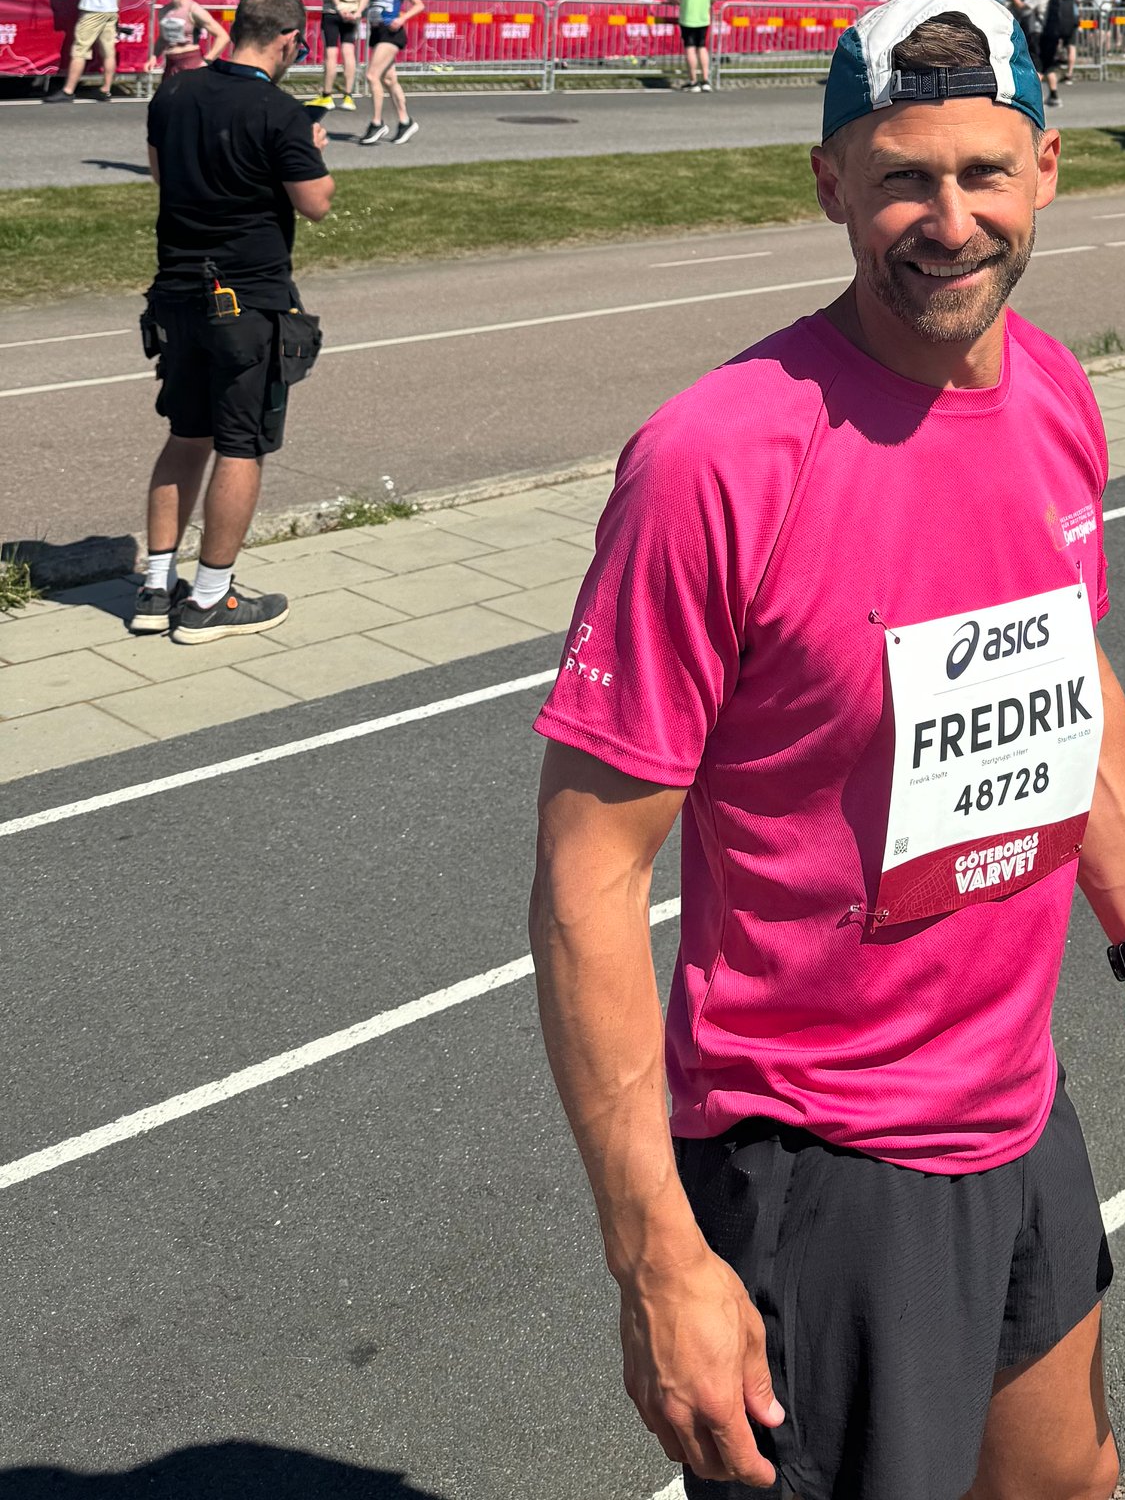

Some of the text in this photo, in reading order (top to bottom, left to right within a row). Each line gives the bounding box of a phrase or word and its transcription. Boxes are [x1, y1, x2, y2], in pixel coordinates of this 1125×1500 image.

[912, 676, 1093, 769] FREDRIK
[953, 762, 1049, 816] 48728
[955, 831, 1039, 872] GÖTEBORGS
[955, 847, 1038, 894] VARVET
